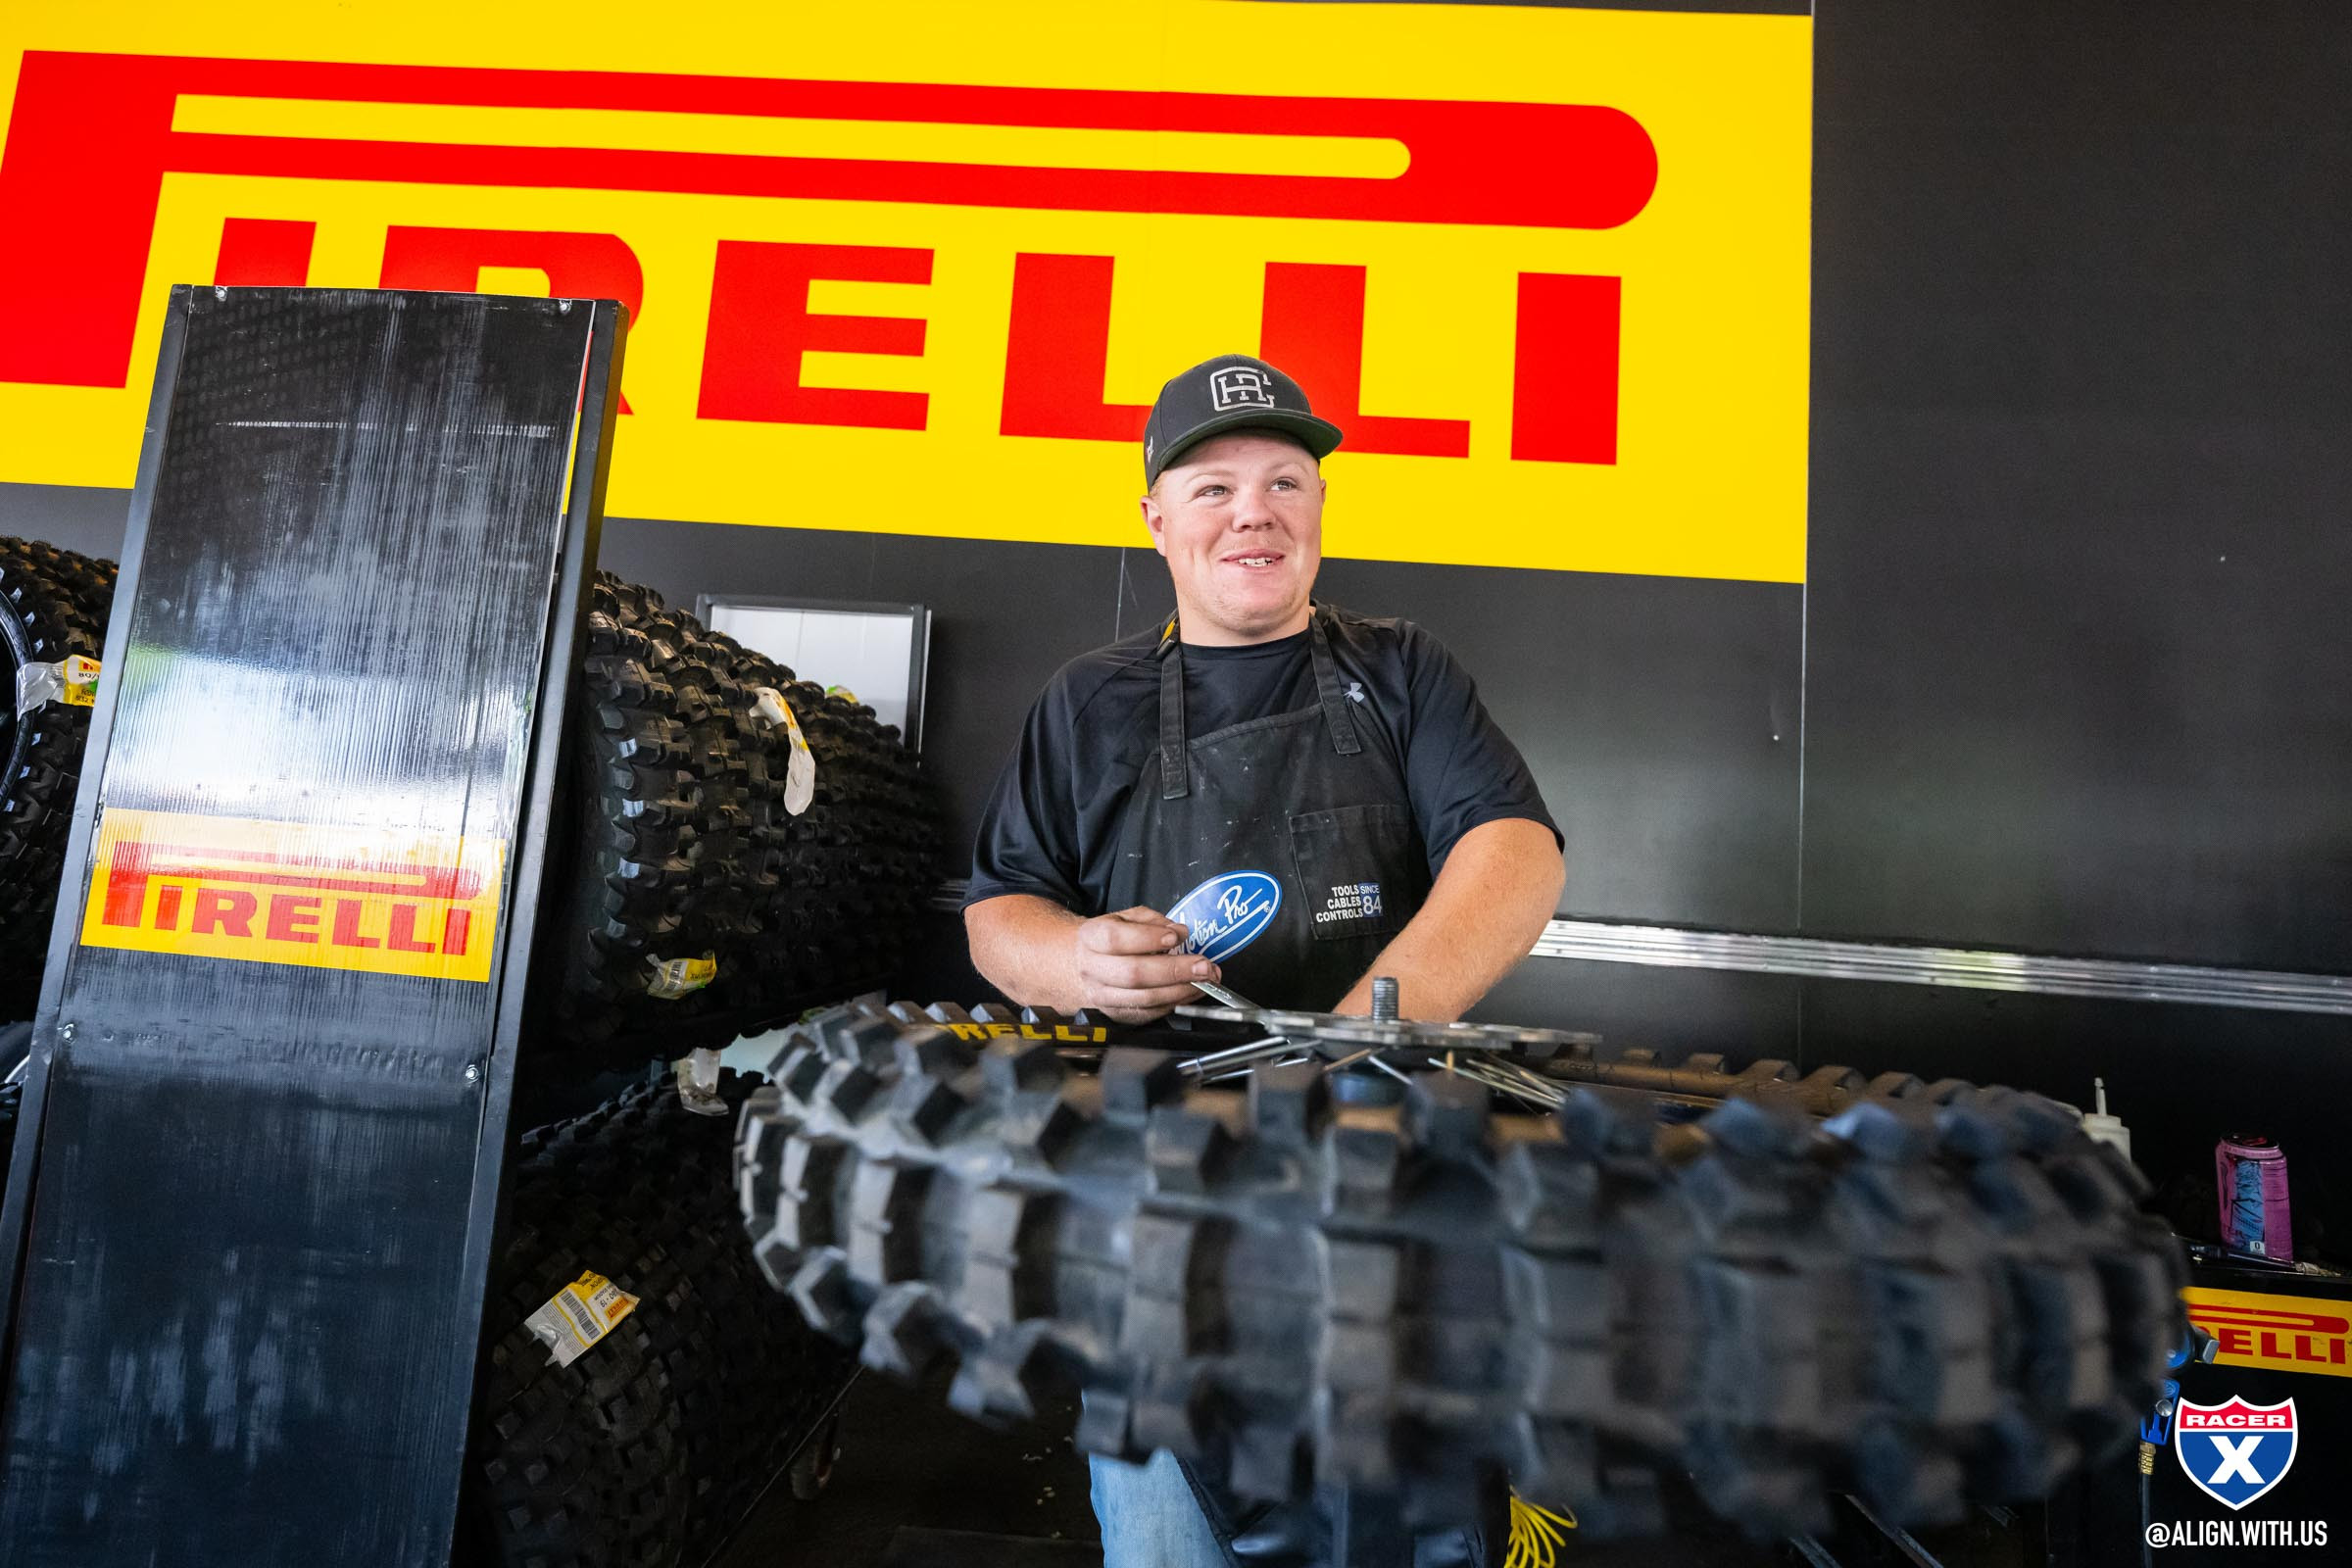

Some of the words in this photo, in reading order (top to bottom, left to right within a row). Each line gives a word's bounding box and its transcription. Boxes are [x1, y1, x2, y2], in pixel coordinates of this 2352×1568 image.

[102, 840, 481, 956] PIRELLI
[1331, 884, 1359, 897] TOOLS
[1359, 884, 1380, 895] SINCE
[1216, 885, 1263, 924] Pro
[1327, 896, 1361, 909] CABLES
[1362, 895, 1383, 914] 84
[1316, 907, 1363, 923] CONTROLS
[936, 1023, 1107, 1043] RELLI
[2188, 1303, 2350, 1364] ELLI
